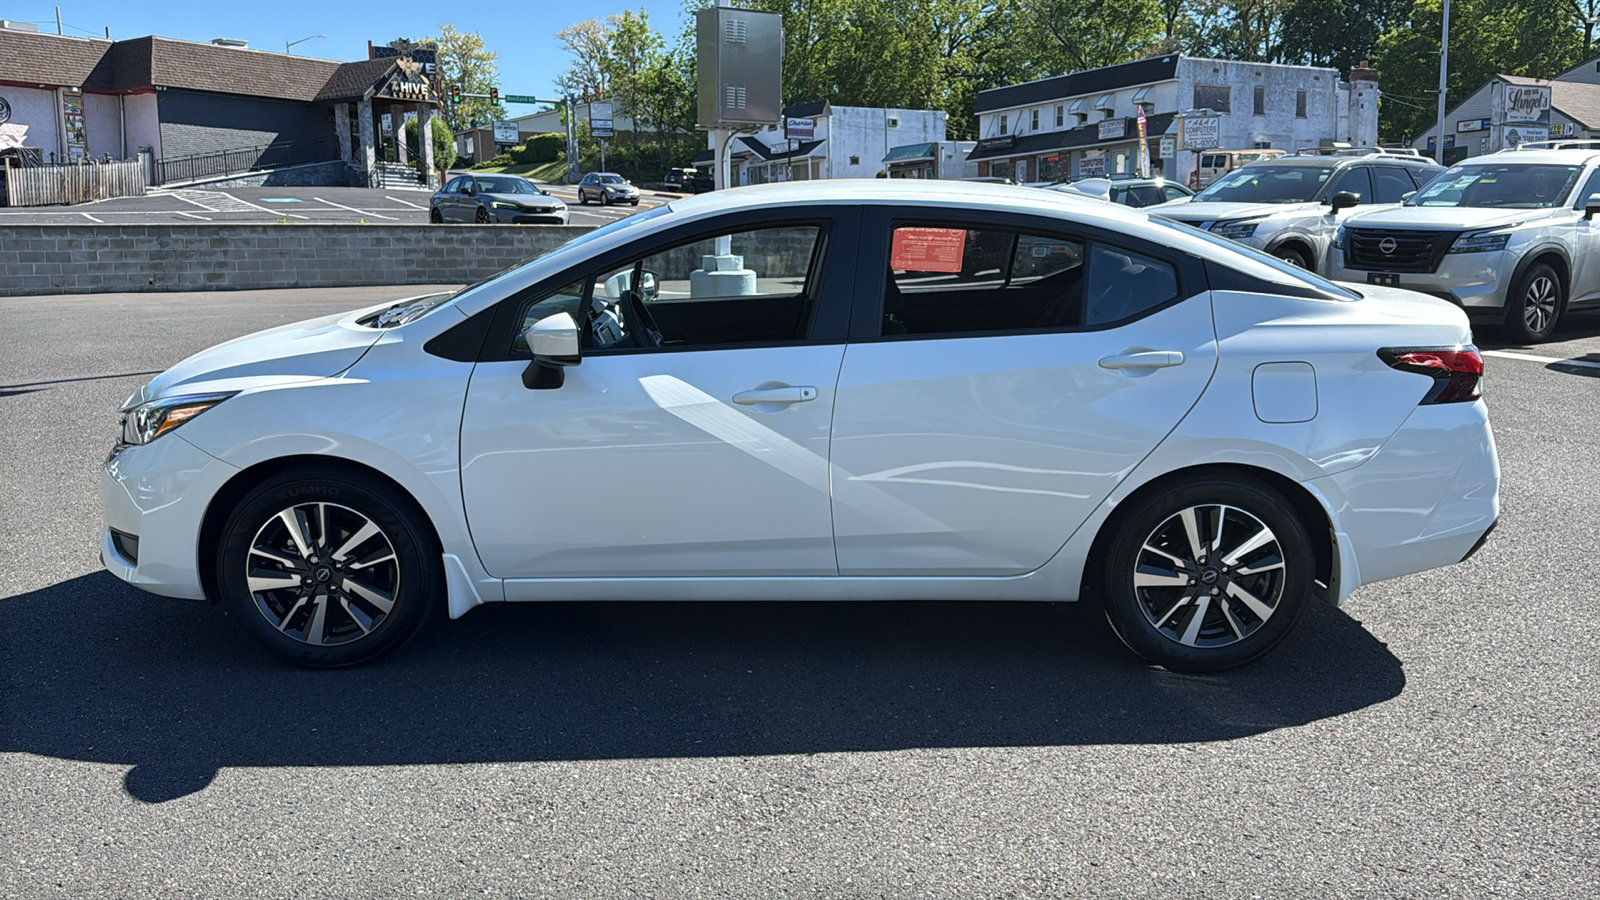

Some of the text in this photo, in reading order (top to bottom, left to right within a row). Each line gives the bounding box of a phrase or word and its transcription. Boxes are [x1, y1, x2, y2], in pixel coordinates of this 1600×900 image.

[400, 81, 428, 95] HIVE
[1507, 88, 1548, 114] Langel's
[1186, 126, 1217, 134] COMPUTERS
[278, 486, 338, 501] KUMHO
